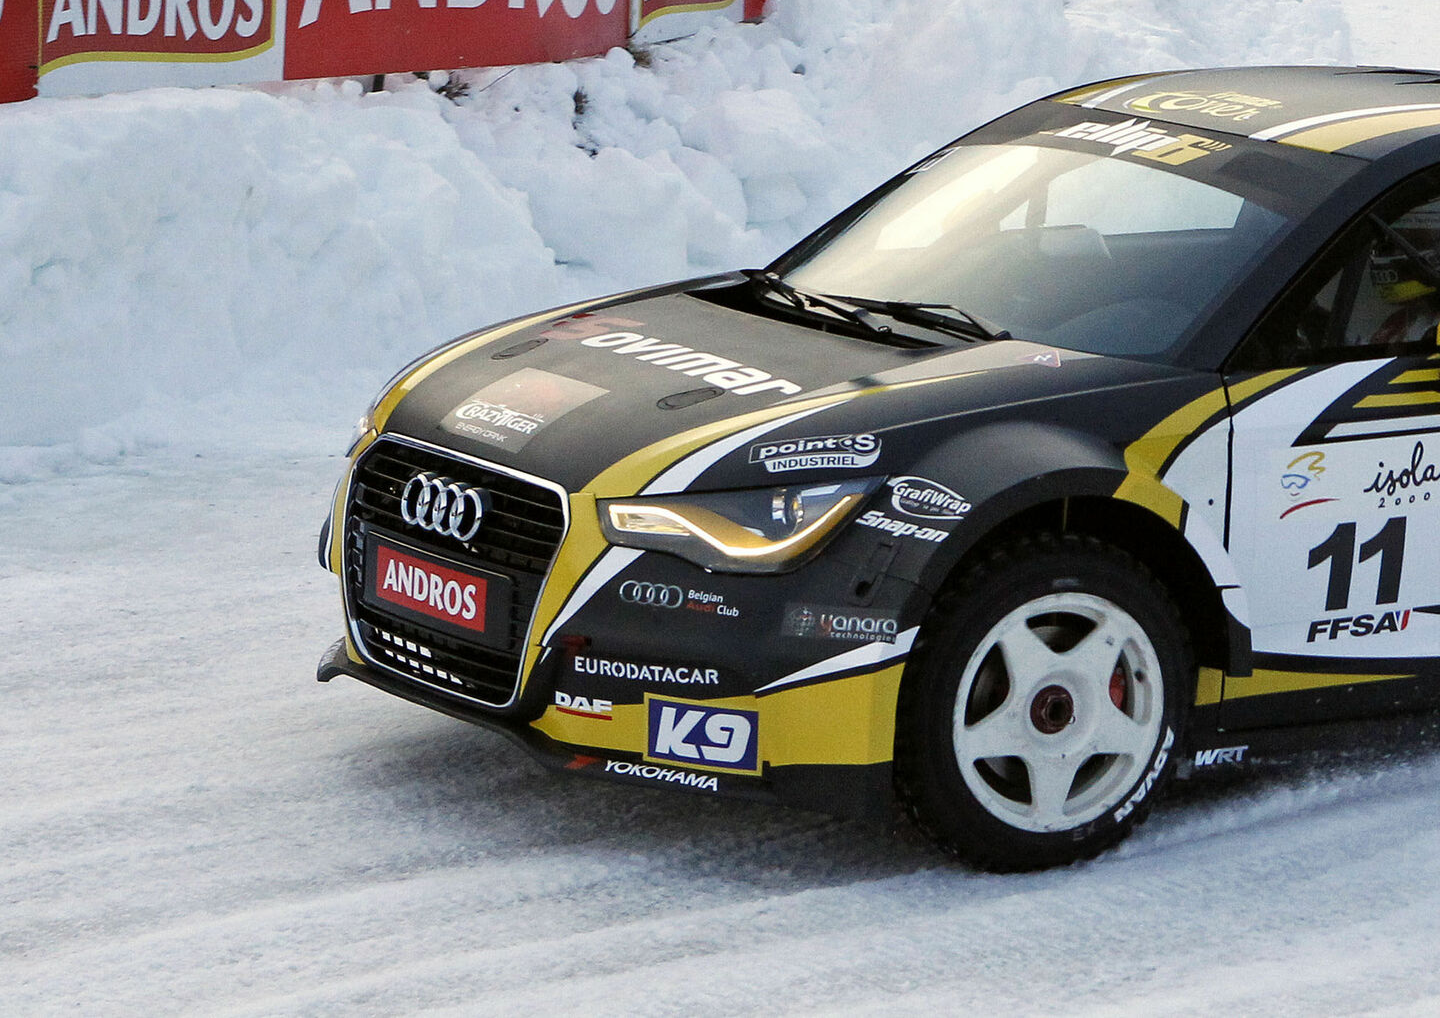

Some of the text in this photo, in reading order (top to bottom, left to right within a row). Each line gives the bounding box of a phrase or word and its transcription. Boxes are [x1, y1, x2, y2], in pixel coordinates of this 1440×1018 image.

[773, 455, 859, 470] INDUSTRIEL
[893, 482, 973, 514] GrafiWrap
[1307, 515, 1407, 611] 11
[383, 558, 477, 620] ANDROS
[687, 589, 724, 604] Belgian
[716, 604, 740, 617] Club
[1306, 610, 1402, 643] FFSA
[574, 655, 719, 685] EURODATACAR
[555, 691, 613, 713] DAF
[655, 705, 751, 763] K9
[1195, 745, 1249, 766] WRT
[604, 759, 719, 792] YOKOHAMA
[1113, 725, 1175, 823] ADVAN
